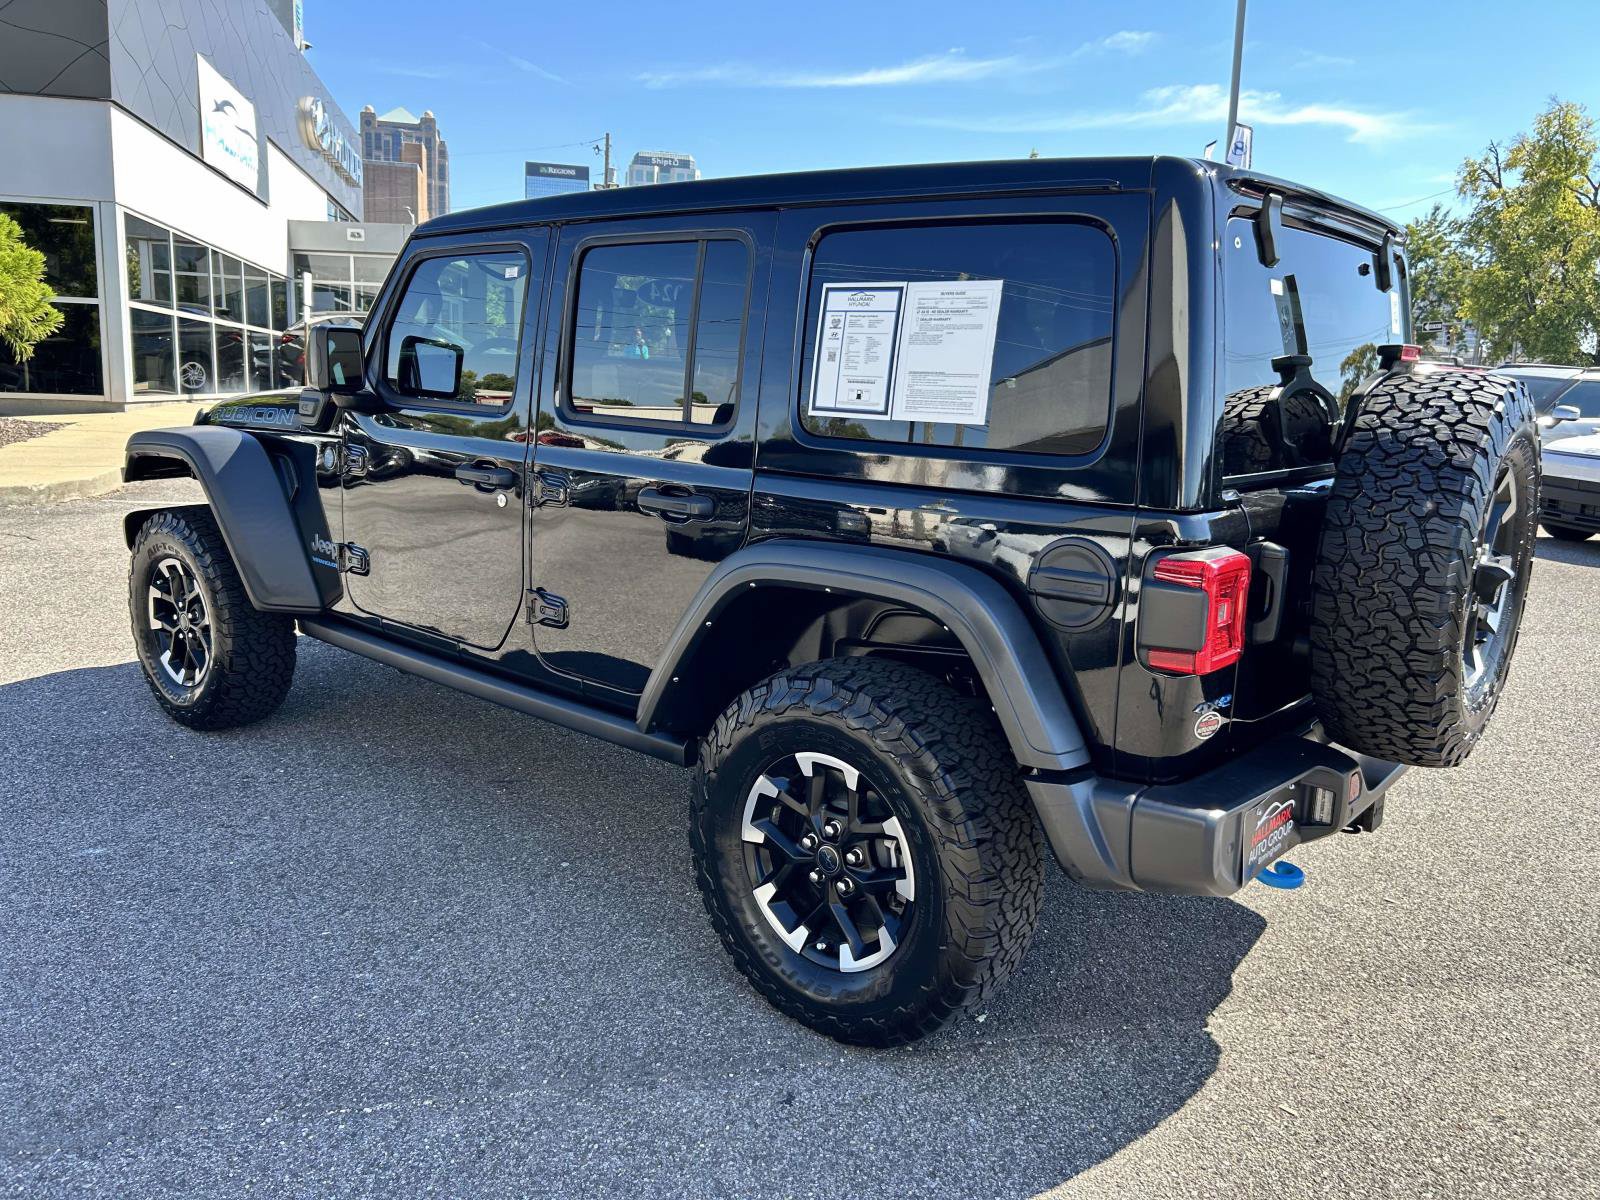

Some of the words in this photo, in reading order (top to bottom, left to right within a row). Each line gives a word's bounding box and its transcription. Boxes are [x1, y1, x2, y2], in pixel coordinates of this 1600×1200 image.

[548, 167, 576, 176] REGIONS
[651, 157, 673, 167] Shipt
[210, 406, 296, 425] RUBICON
[311, 533, 338, 560] Jeep
[1250, 806, 1293, 848] HALLMARK
[1248, 838, 1268, 866] AUTO
[1267, 819, 1295, 847] GROUP
